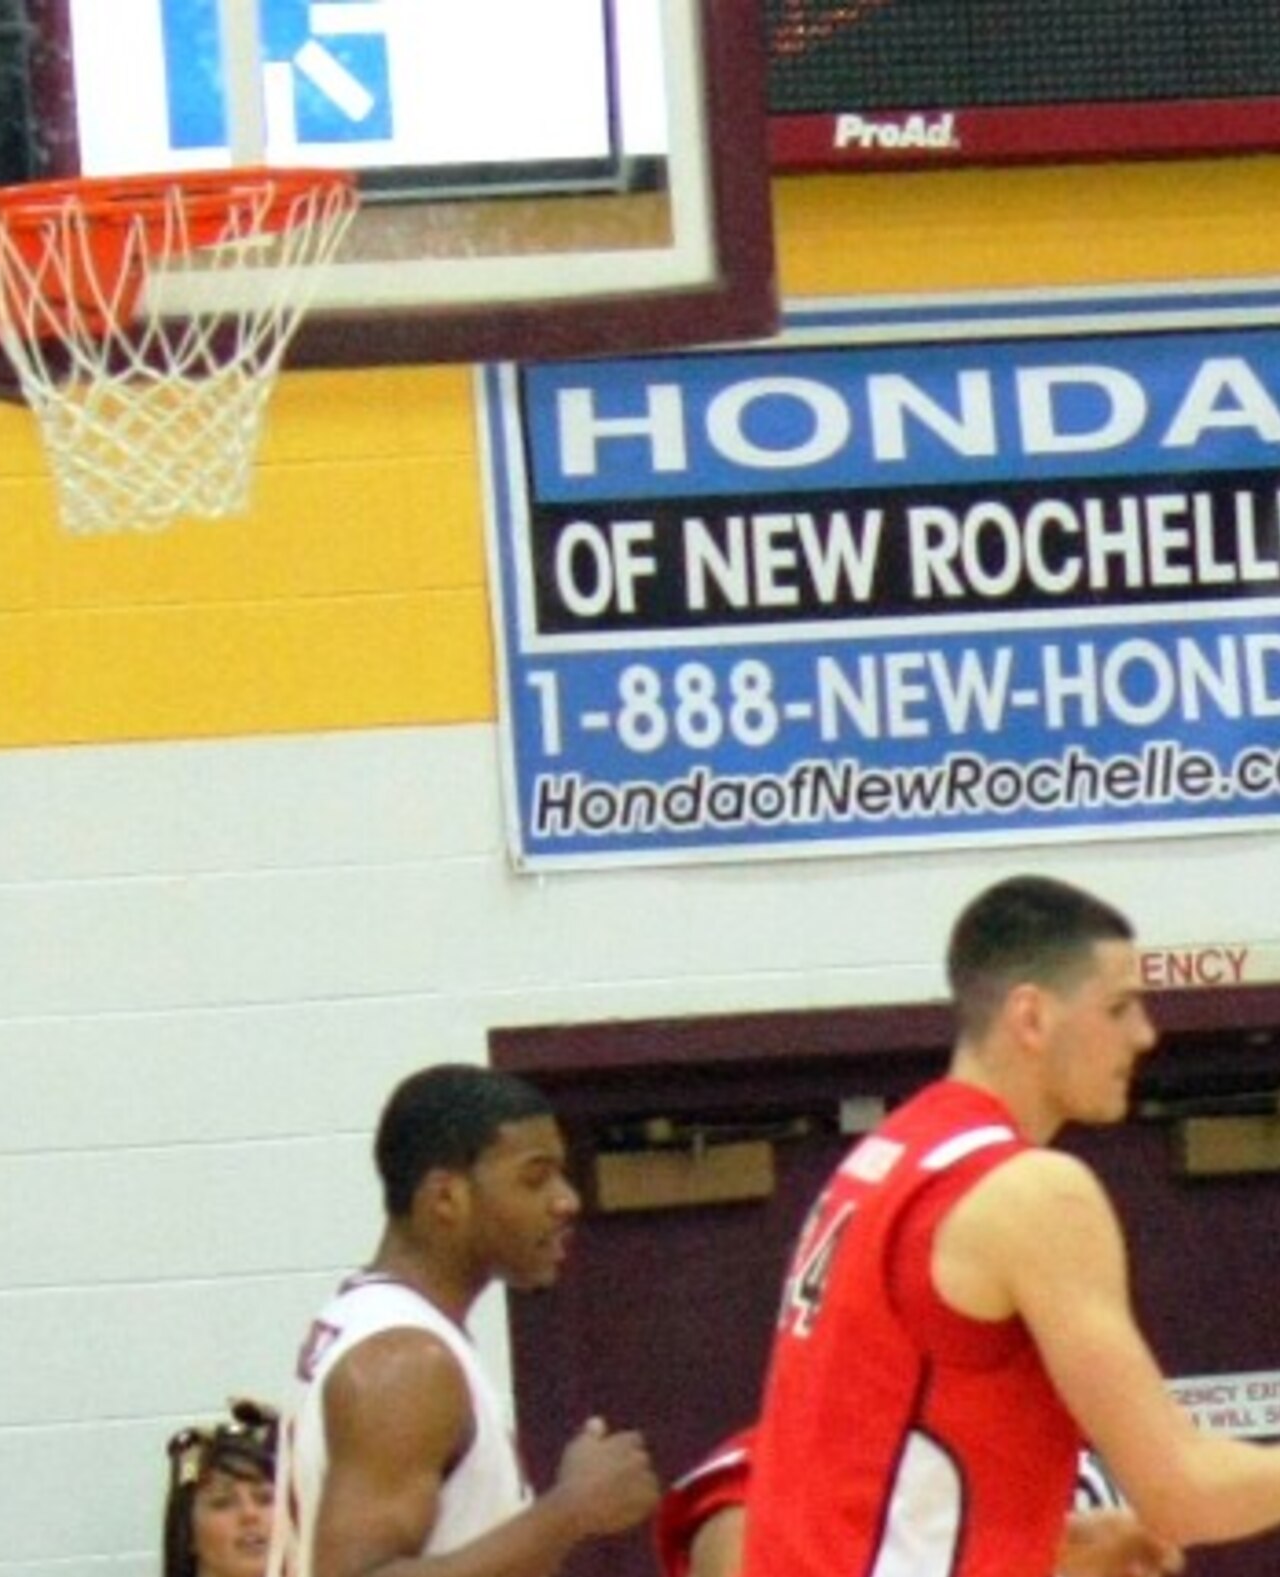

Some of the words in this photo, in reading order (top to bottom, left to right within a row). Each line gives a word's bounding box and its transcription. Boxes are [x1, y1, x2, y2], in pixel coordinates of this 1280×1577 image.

[554, 521, 655, 618] OF
[683, 508, 883, 612] NEW
[1208, 1409, 1256, 1427] WILL
